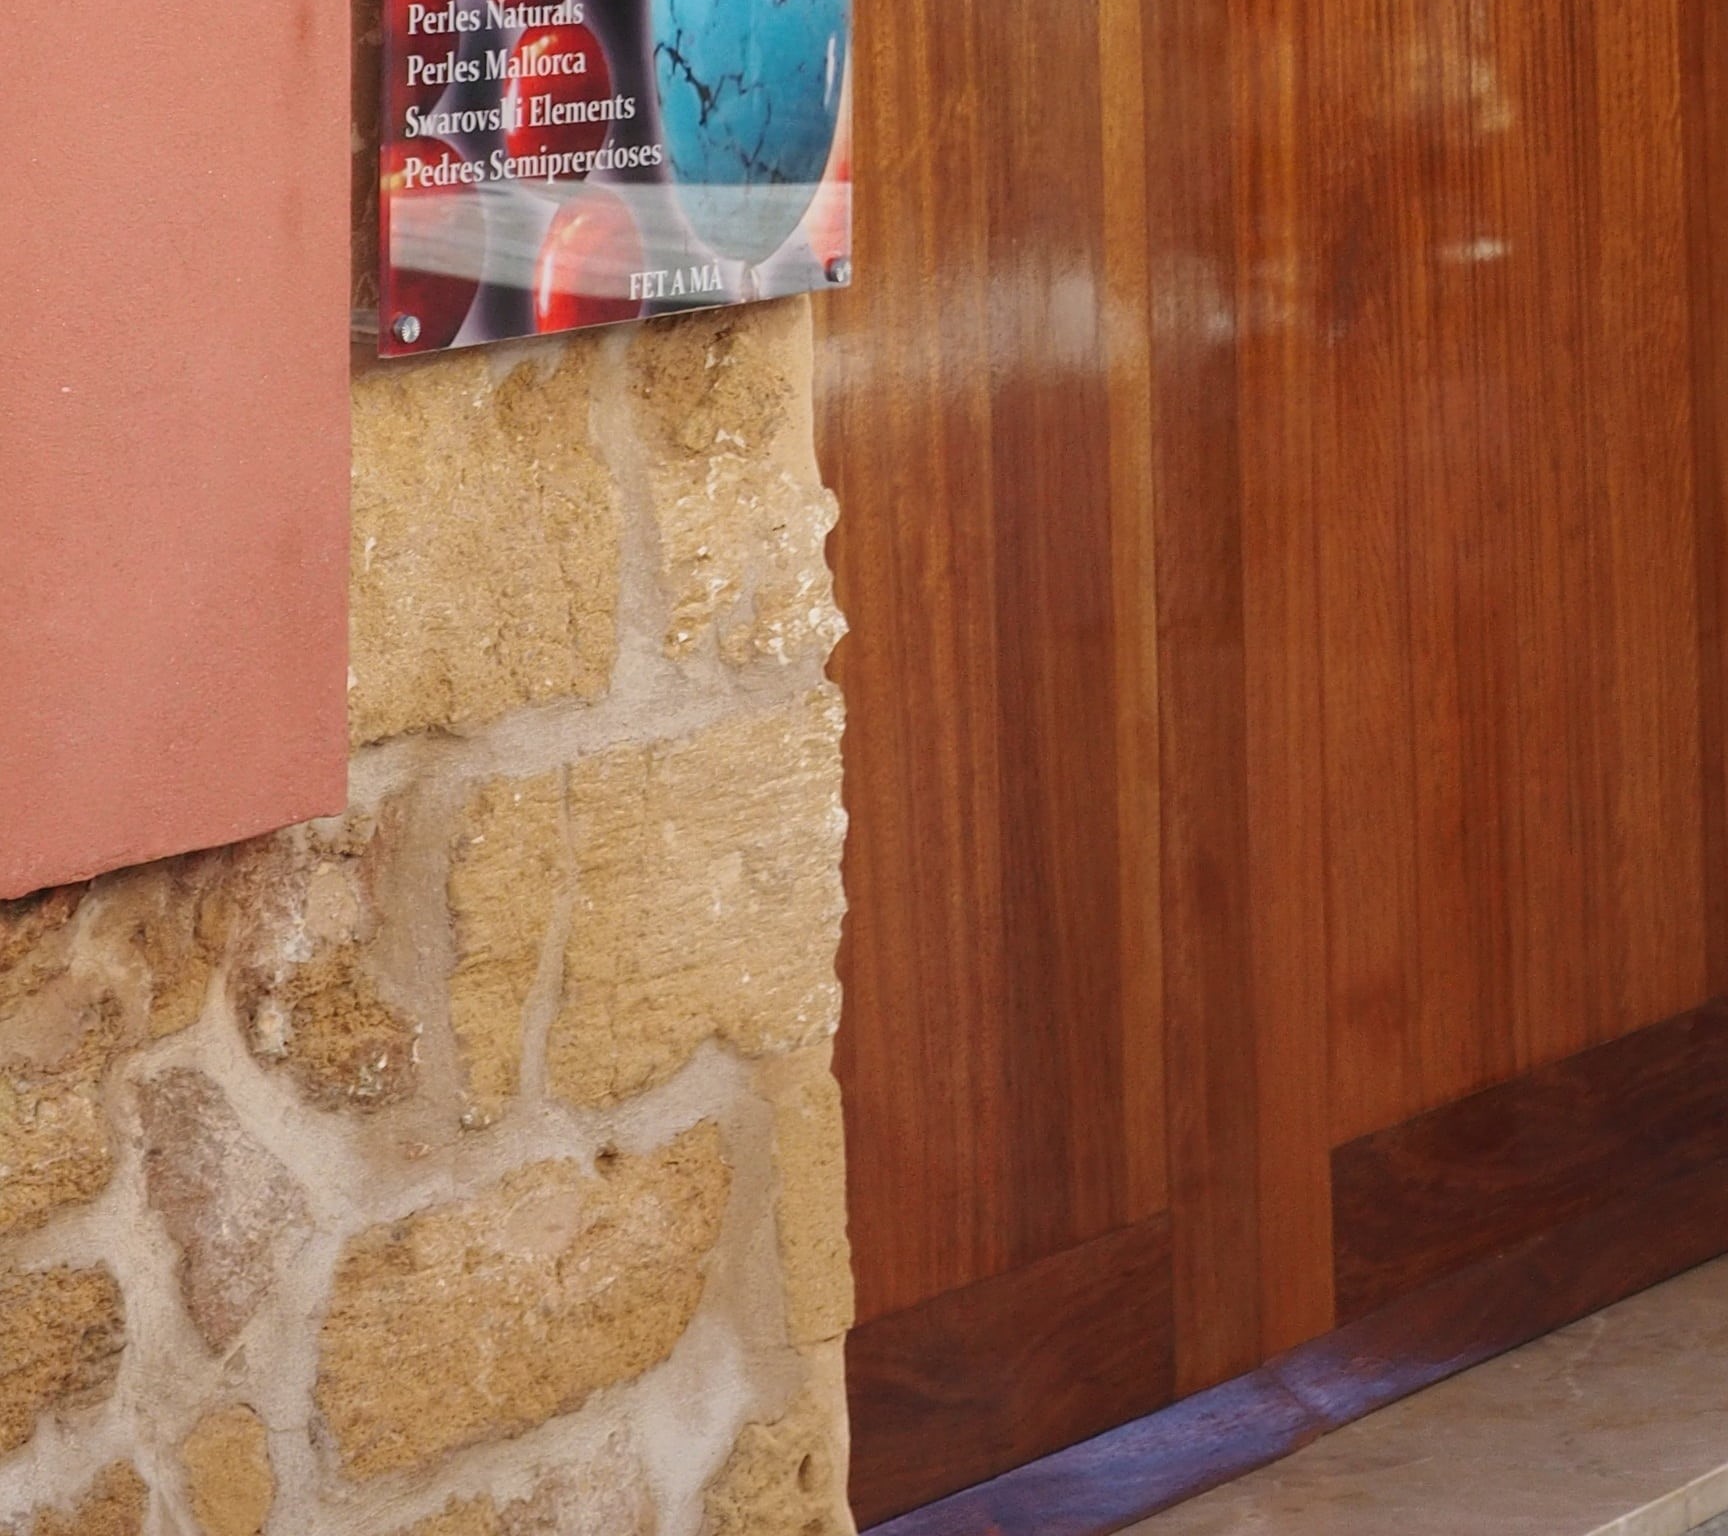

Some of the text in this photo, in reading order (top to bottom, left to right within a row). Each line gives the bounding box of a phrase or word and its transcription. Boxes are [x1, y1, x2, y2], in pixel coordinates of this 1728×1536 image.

[408, 0, 480, 35] Perles
[406, 44, 586, 86] Perles Mallorca
[528, 93, 636, 127] Elements
[404, 153, 485, 189] Pedres
[628, 269, 669, 301] FET
[670, 267, 687, 296] A
